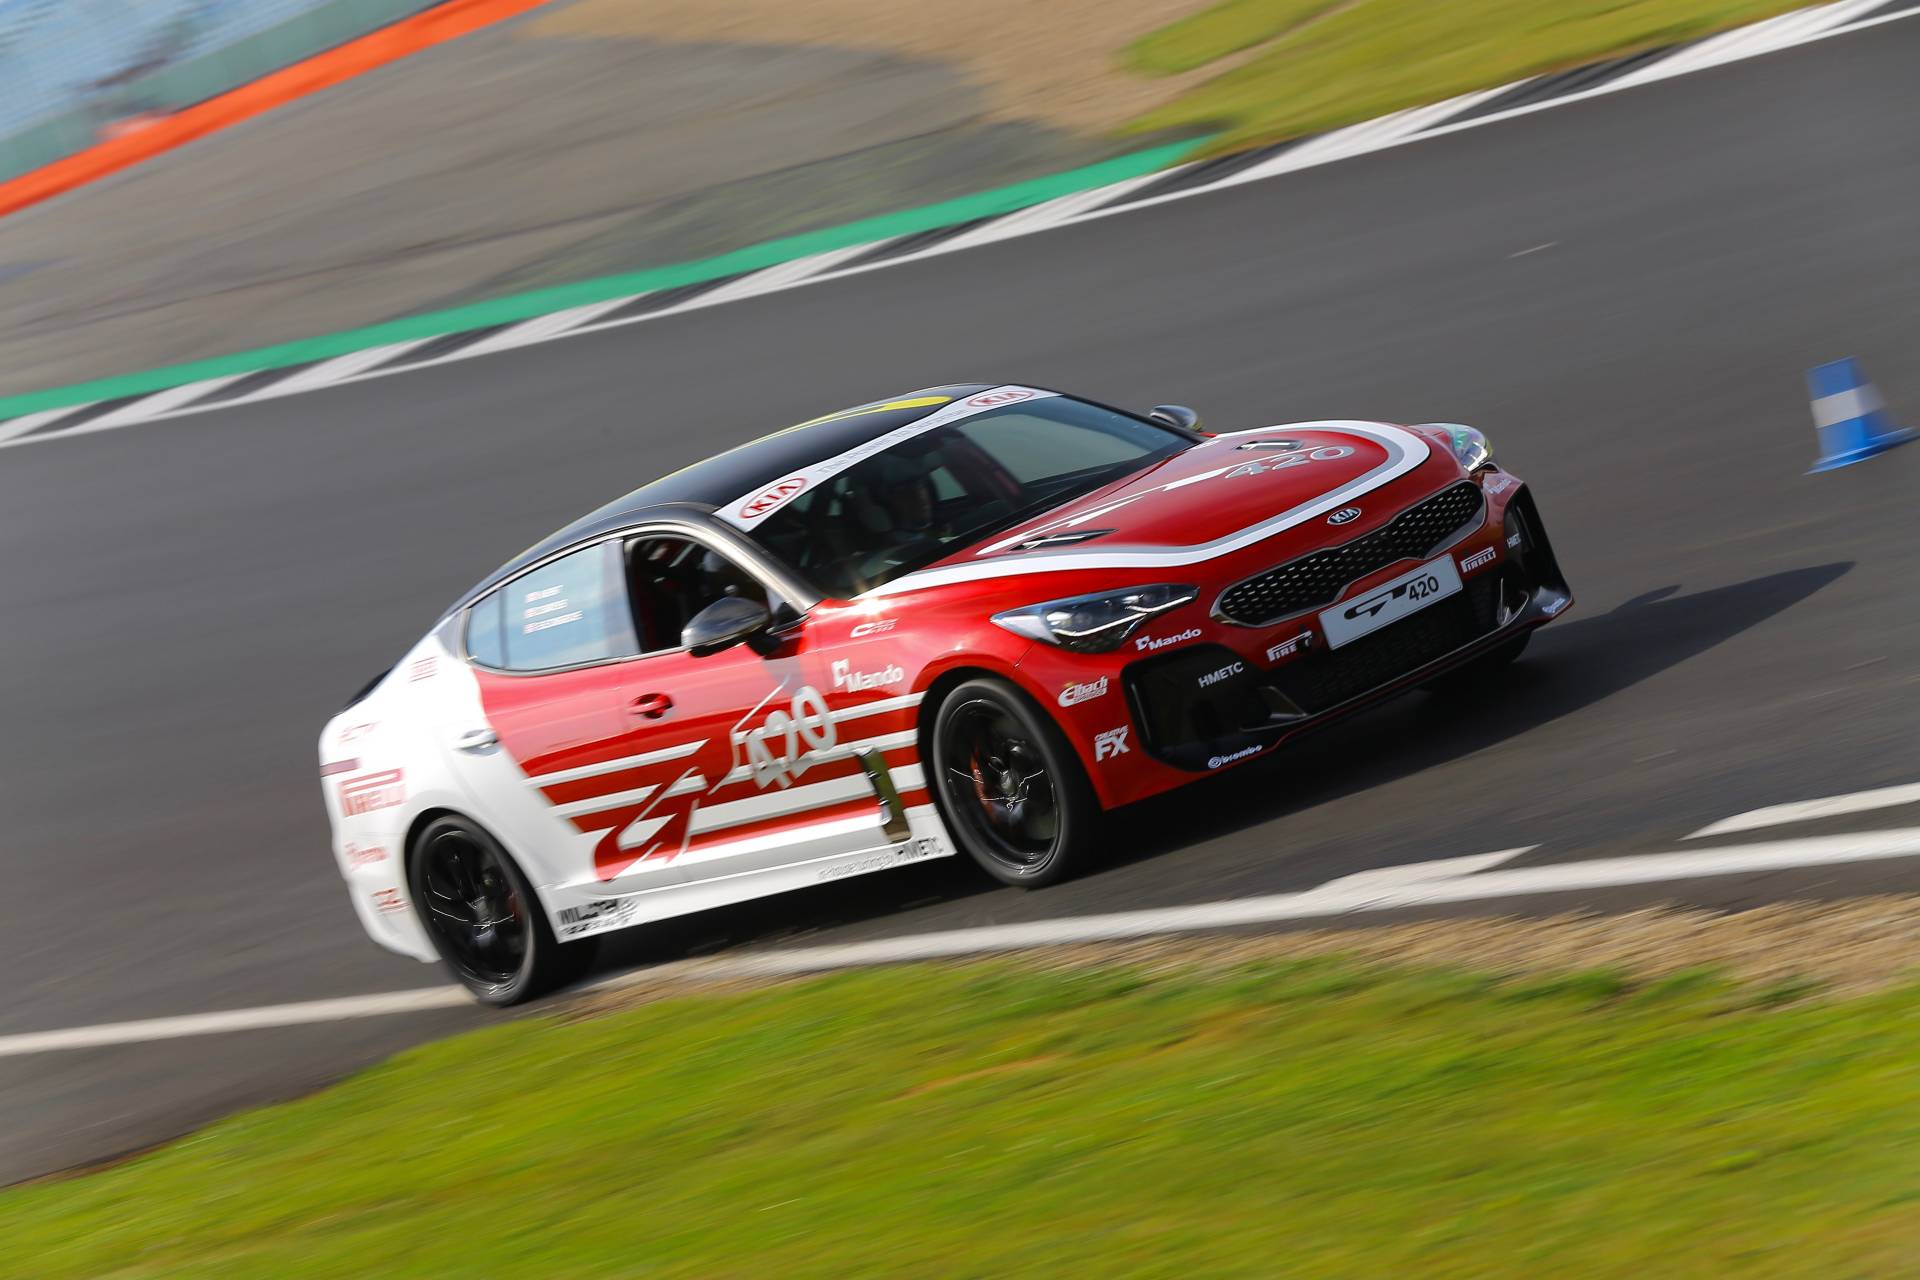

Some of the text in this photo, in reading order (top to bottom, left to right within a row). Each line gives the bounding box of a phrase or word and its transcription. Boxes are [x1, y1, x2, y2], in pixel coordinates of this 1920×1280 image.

[978, 391, 1024, 407] KIA
[1225, 445, 1356, 479] 420
[748, 484, 798, 512] KIA
[1332, 507, 1359, 523] KIA
[1460, 546, 1497, 574] PIRELLI
[1408, 577, 1440, 602] 420
[1148, 628, 1202, 651] Mando
[847, 664, 905, 694] Mando
[1198, 661, 1244, 688] HMETC
[745, 685, 837, 790] 420
[1094, 731, 1130, 762] FX
[1220, 744, 1263, 765] brembo
